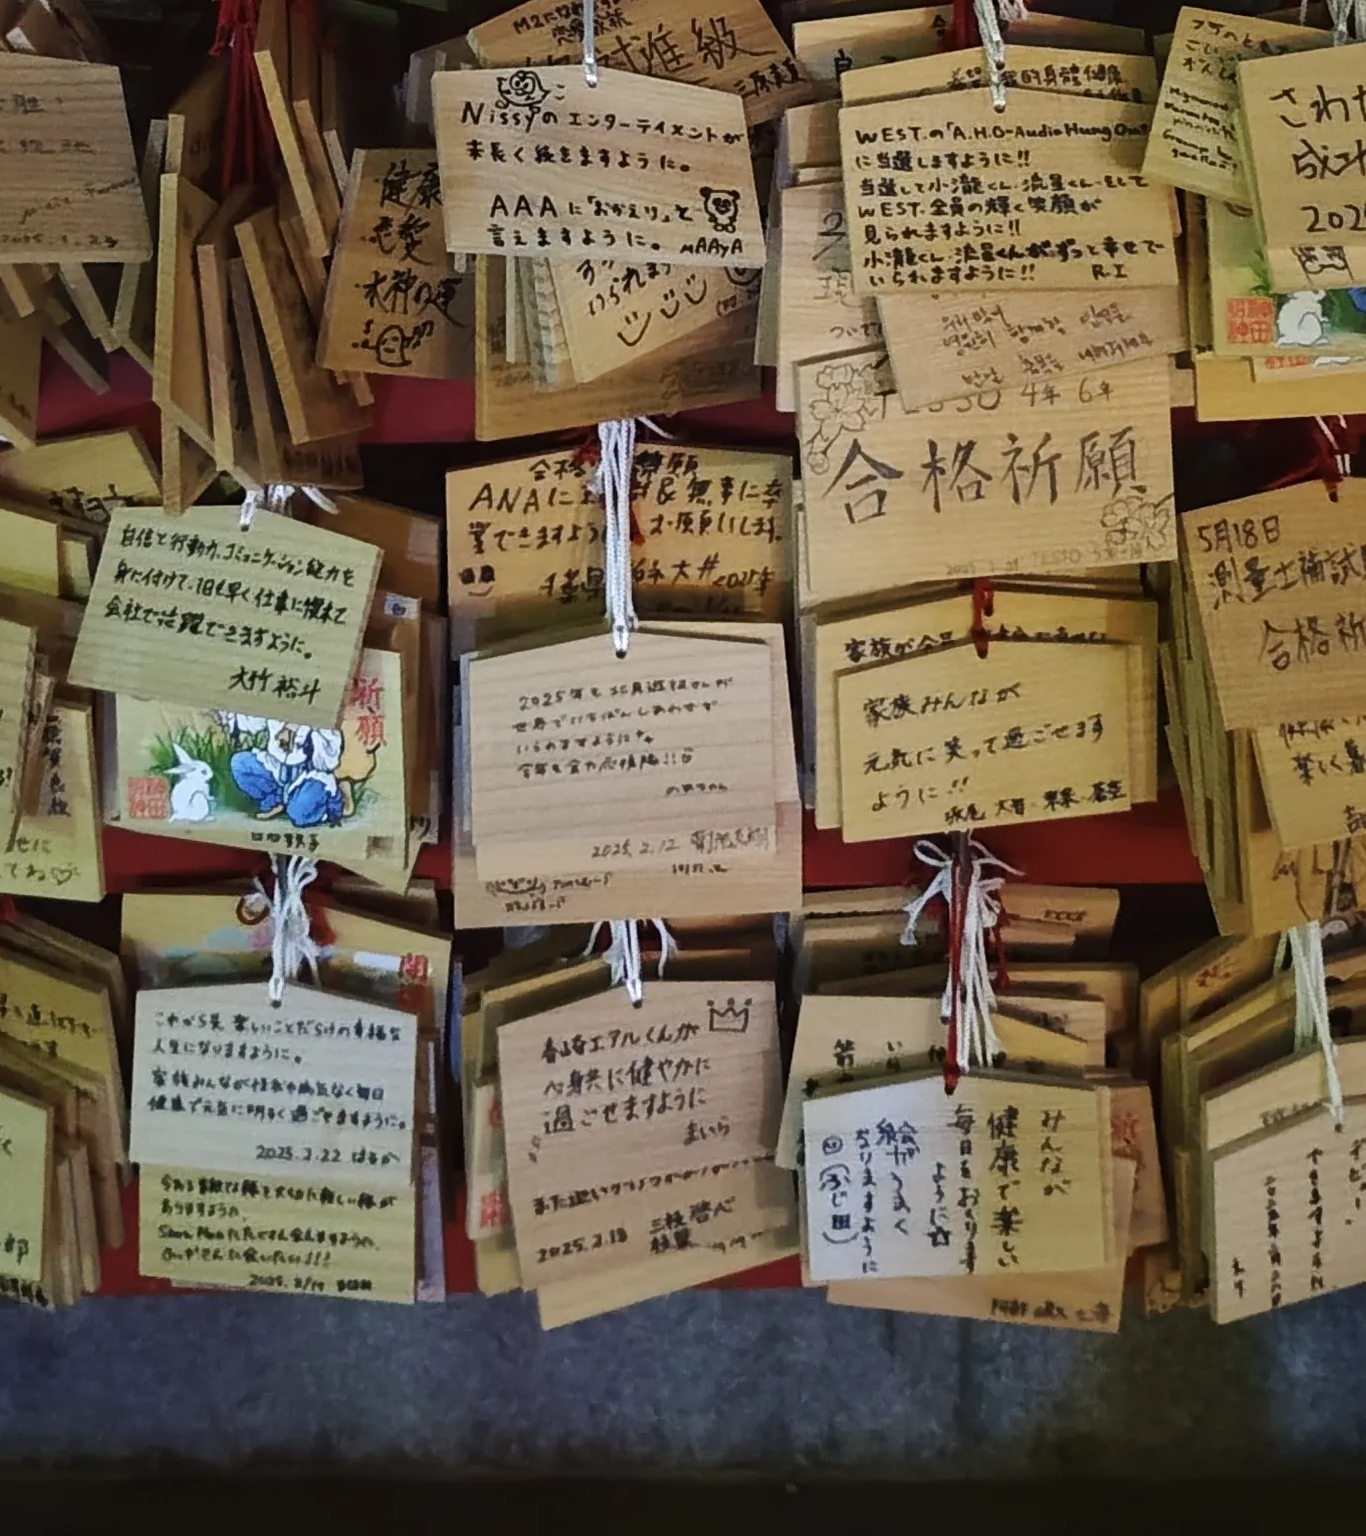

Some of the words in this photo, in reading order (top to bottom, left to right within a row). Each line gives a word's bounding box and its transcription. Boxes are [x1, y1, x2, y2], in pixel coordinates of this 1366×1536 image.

[856, 150, 1030, 172] に当選しますように!!
[487, 225, 663, 251] 言えますように。
[864, 220, 1022, 244] 見られますように!!
[869, 264, 1035, 287] いられますように!!
[822, 425, 1148, 524] 合格祈願
[1197, 516, 1283, 553] 5月18日
[862, 681, 1022, 727] 家族みんなが
[1037, 1107, 1071, 1198] みんなが
[986, 1104, 1023, 1270] 健康で楽しい
